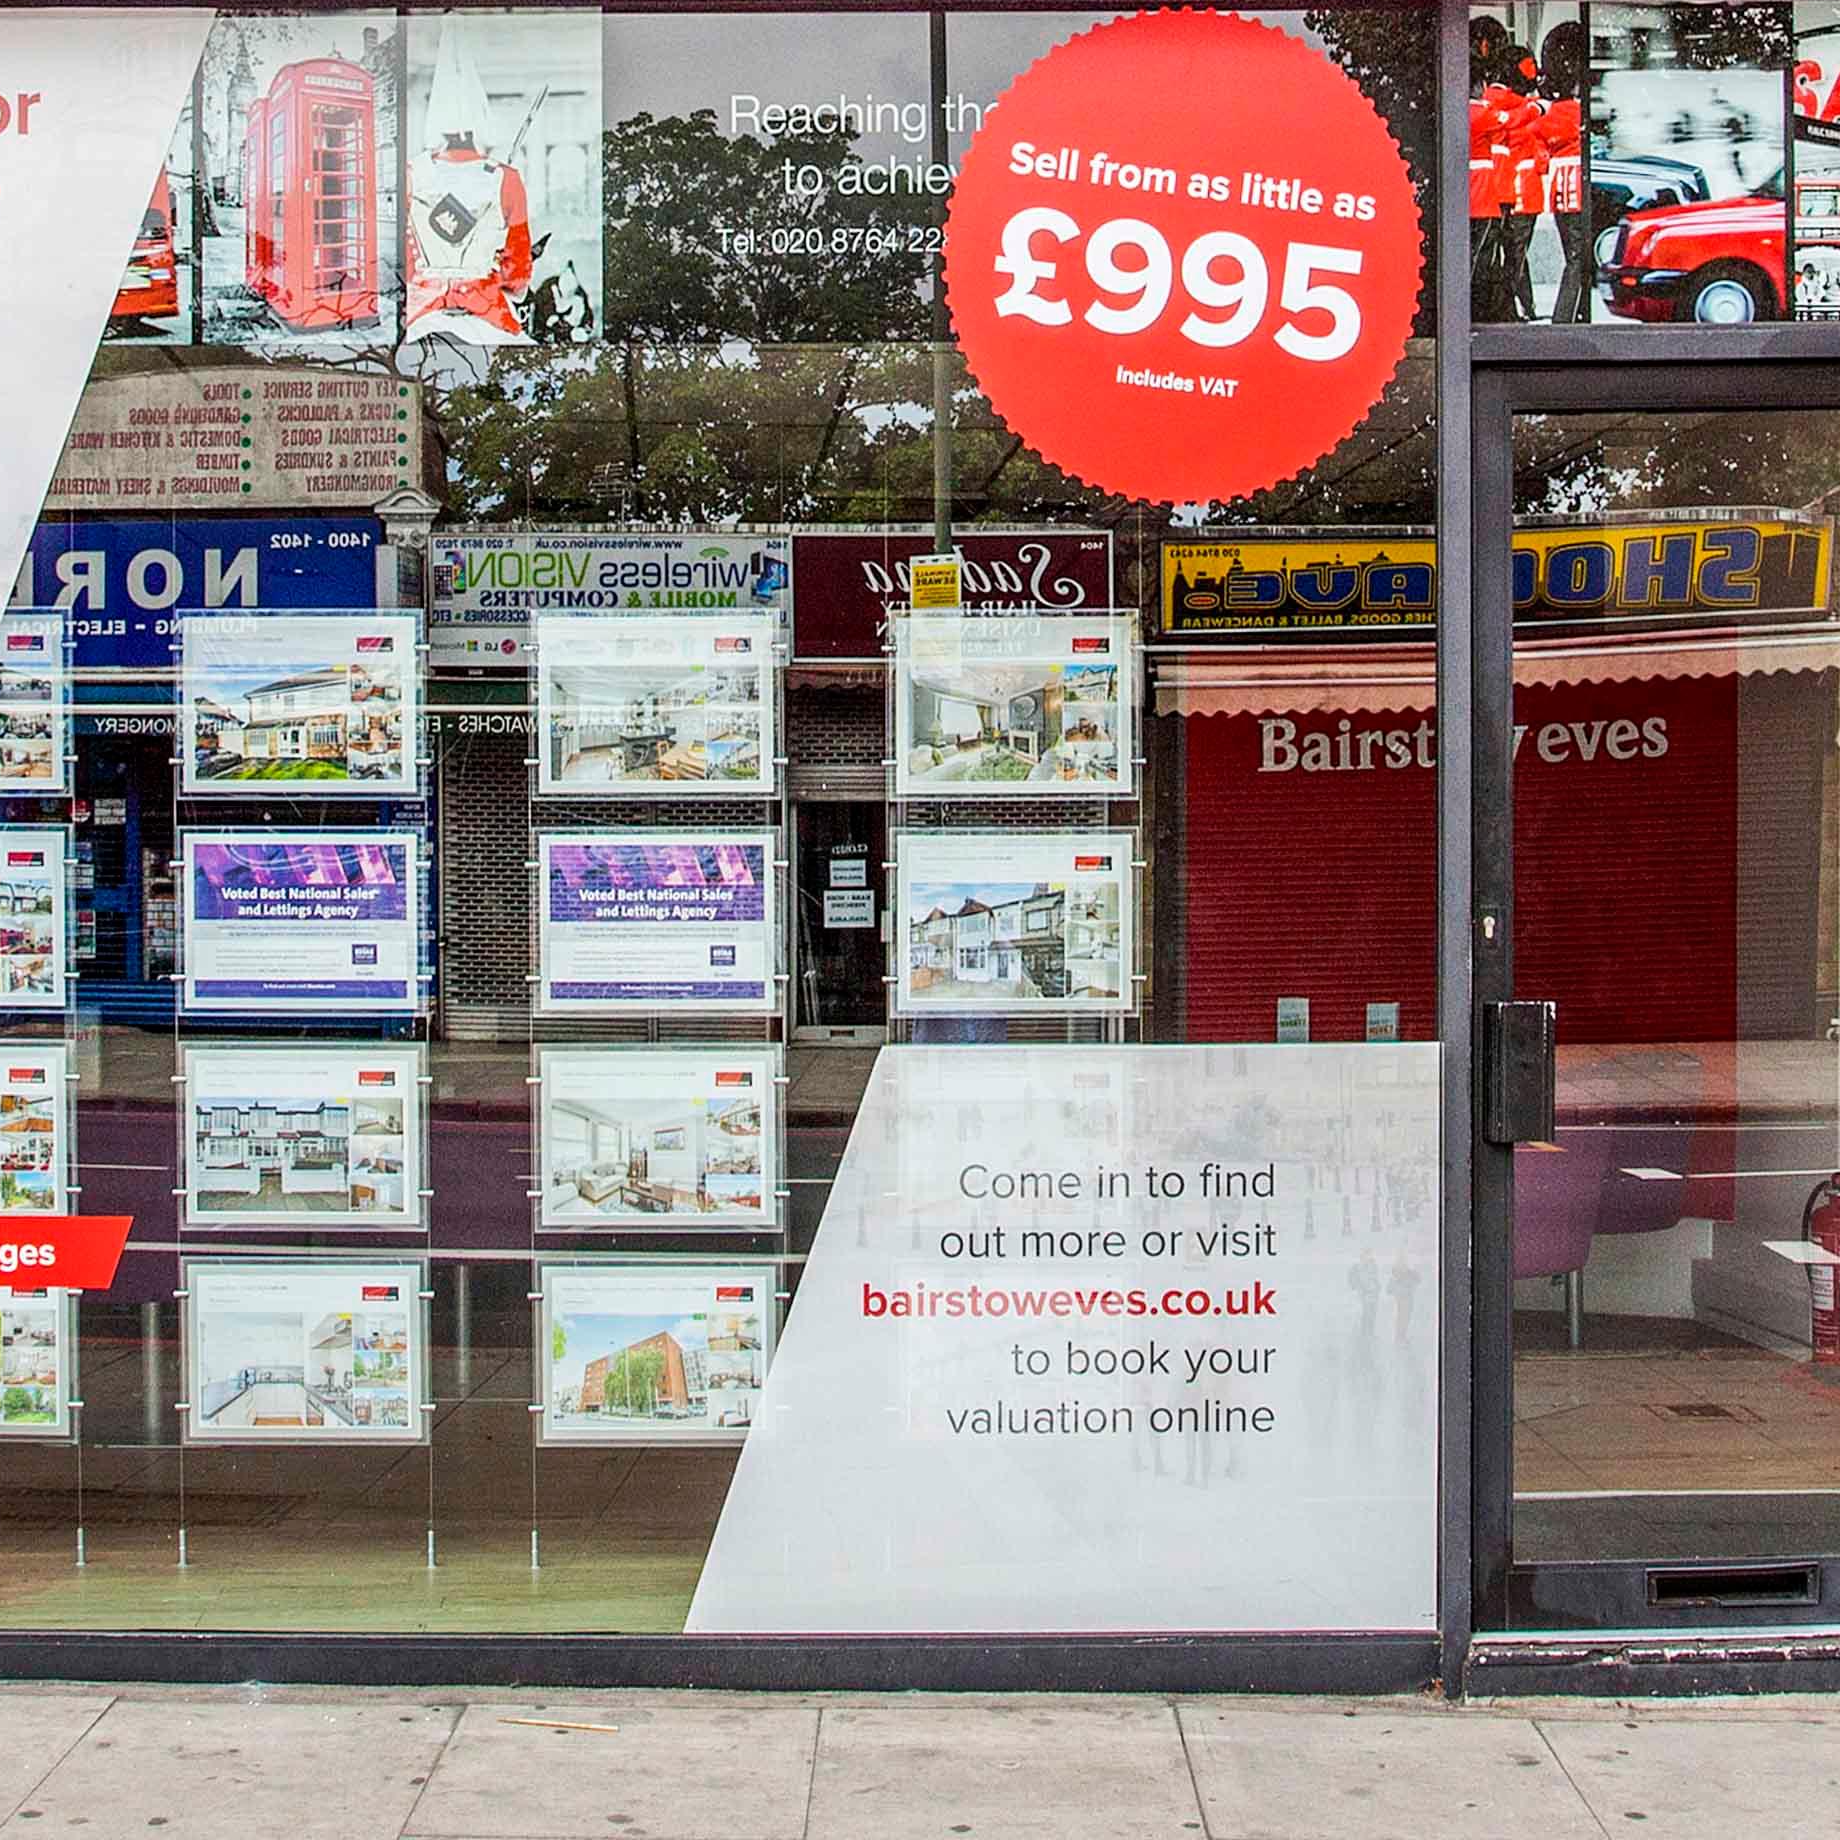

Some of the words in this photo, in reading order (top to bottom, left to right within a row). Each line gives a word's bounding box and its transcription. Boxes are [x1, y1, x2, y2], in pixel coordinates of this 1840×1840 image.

[729, 94, 927, 143] Reaching
[781, 157, 823, 195] to
[1009, 140, 1080, 184] Sell
[1088, 153, 1177, 194] from
[1185, 172, 1231, 202] as
[1240, 173, 1323, 215] little
[1332, 191, 1377, 221] as
[716, 228, 762, 254] Tel:
[770, 228, 823, 254] 020
[830, 228, 899, 254] 8764
[993, 206, 1365, 362] £995
[1116, 364, 1194, 394] Includes
[1199, 376, 1238, 398] VAT
[1538, 713, 1669, 762] eves
[221, 887, 258, 900] Voted
[259, 887, 287, 900] Best
[288, 887, 341, 900] National
[237, 903, 260, 915] and
[262, 903, 312, 919] Lettings
[313, 903, 359, 919] Agency
[578, 888, 615, 902] Voted
[617, 888, 645, 902] Best
[646, 888, 701, 902] National
[702, 888, 733, 902] Sales
[595, 905, 620, 918] and
[621, 905, 671, 920] Lettings
[671, 905, 718, 920] Agency
[959, 1163, 1081, 1200] Come
[1096, 1163, 1131, 1199] in
[1145, 1168, 1186, 1199] to
[1199, 1162, 1277, 1199] find
[939, 1227, 1005, 1259] out
[1020, 1228, 1126, 1258] more
[1141, 1228, 1182, 1258] or
[1195, 1222, 1278, 1258] visit
[862, 1281, 1278, 1318] bairstoweves.co.uk
[1011, 1344, 1051, 1376] to
[1066, 1341, 1170, 1376] book
[1184, 1347, 1277, 1384] your
[946, 1400, 1134, 1435] valuation
[1149, 1399, 1277, 1434] online
